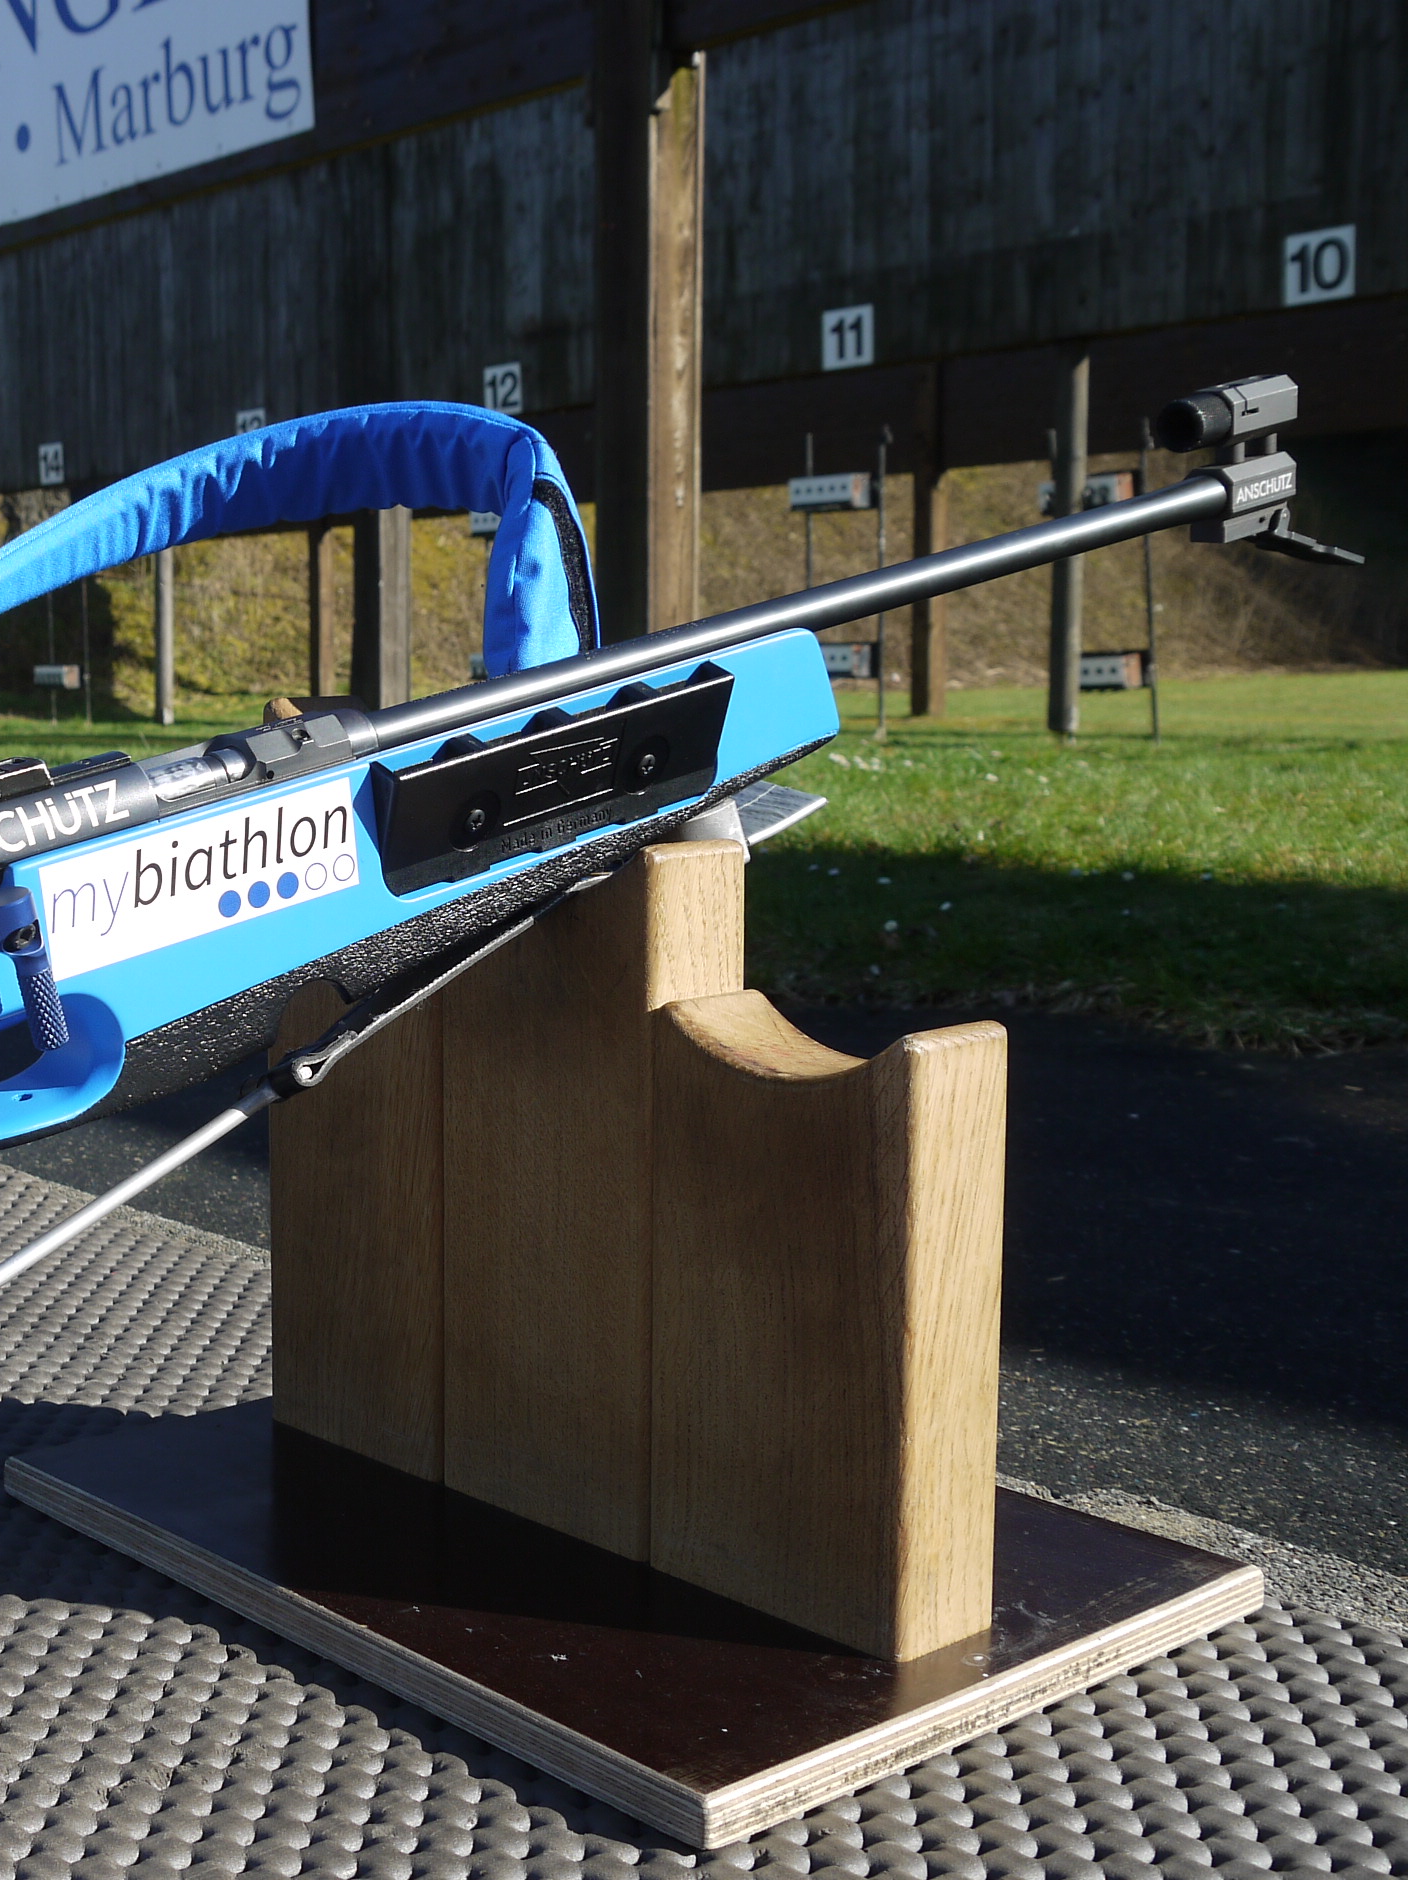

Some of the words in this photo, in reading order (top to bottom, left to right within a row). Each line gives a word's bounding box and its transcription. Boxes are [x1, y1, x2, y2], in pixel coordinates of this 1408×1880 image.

[54, 23, 301, 167] Marburg
[1290, 238, 1349, 294] 10
[832, 315, 863, 359] 11
[488, 370, 519, 409] 12
[41, 449, 62, 478] 14
[1236, 472, 1293, 504] ANSCHÜTZ
[51, 805, 349, 937] mybiathlon
